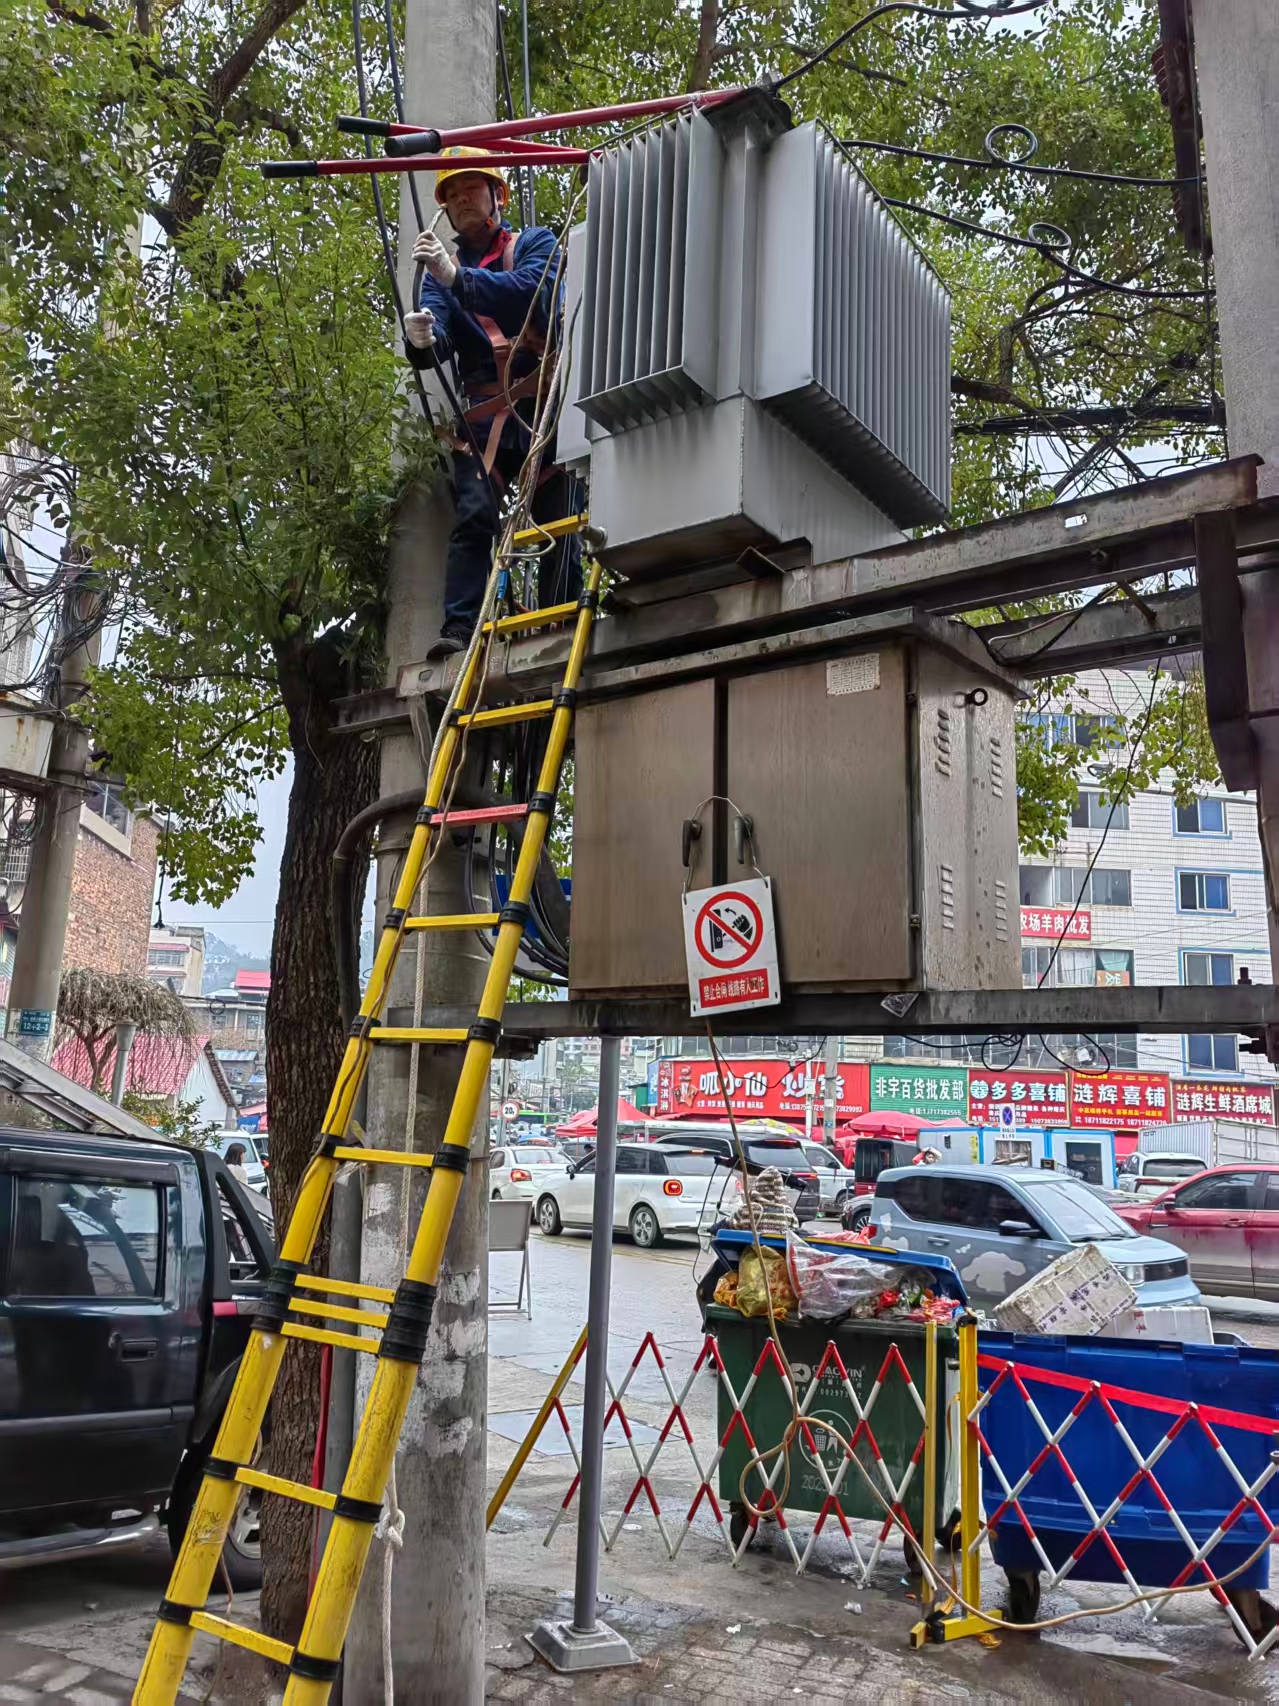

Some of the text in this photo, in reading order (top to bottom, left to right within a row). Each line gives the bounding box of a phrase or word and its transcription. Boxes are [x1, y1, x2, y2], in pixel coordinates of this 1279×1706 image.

[1073, 1083, 1167, 1108] 涟辉喜铺
[1176, 1092, 1273, 1116] 涟辉生鲜酒席城
